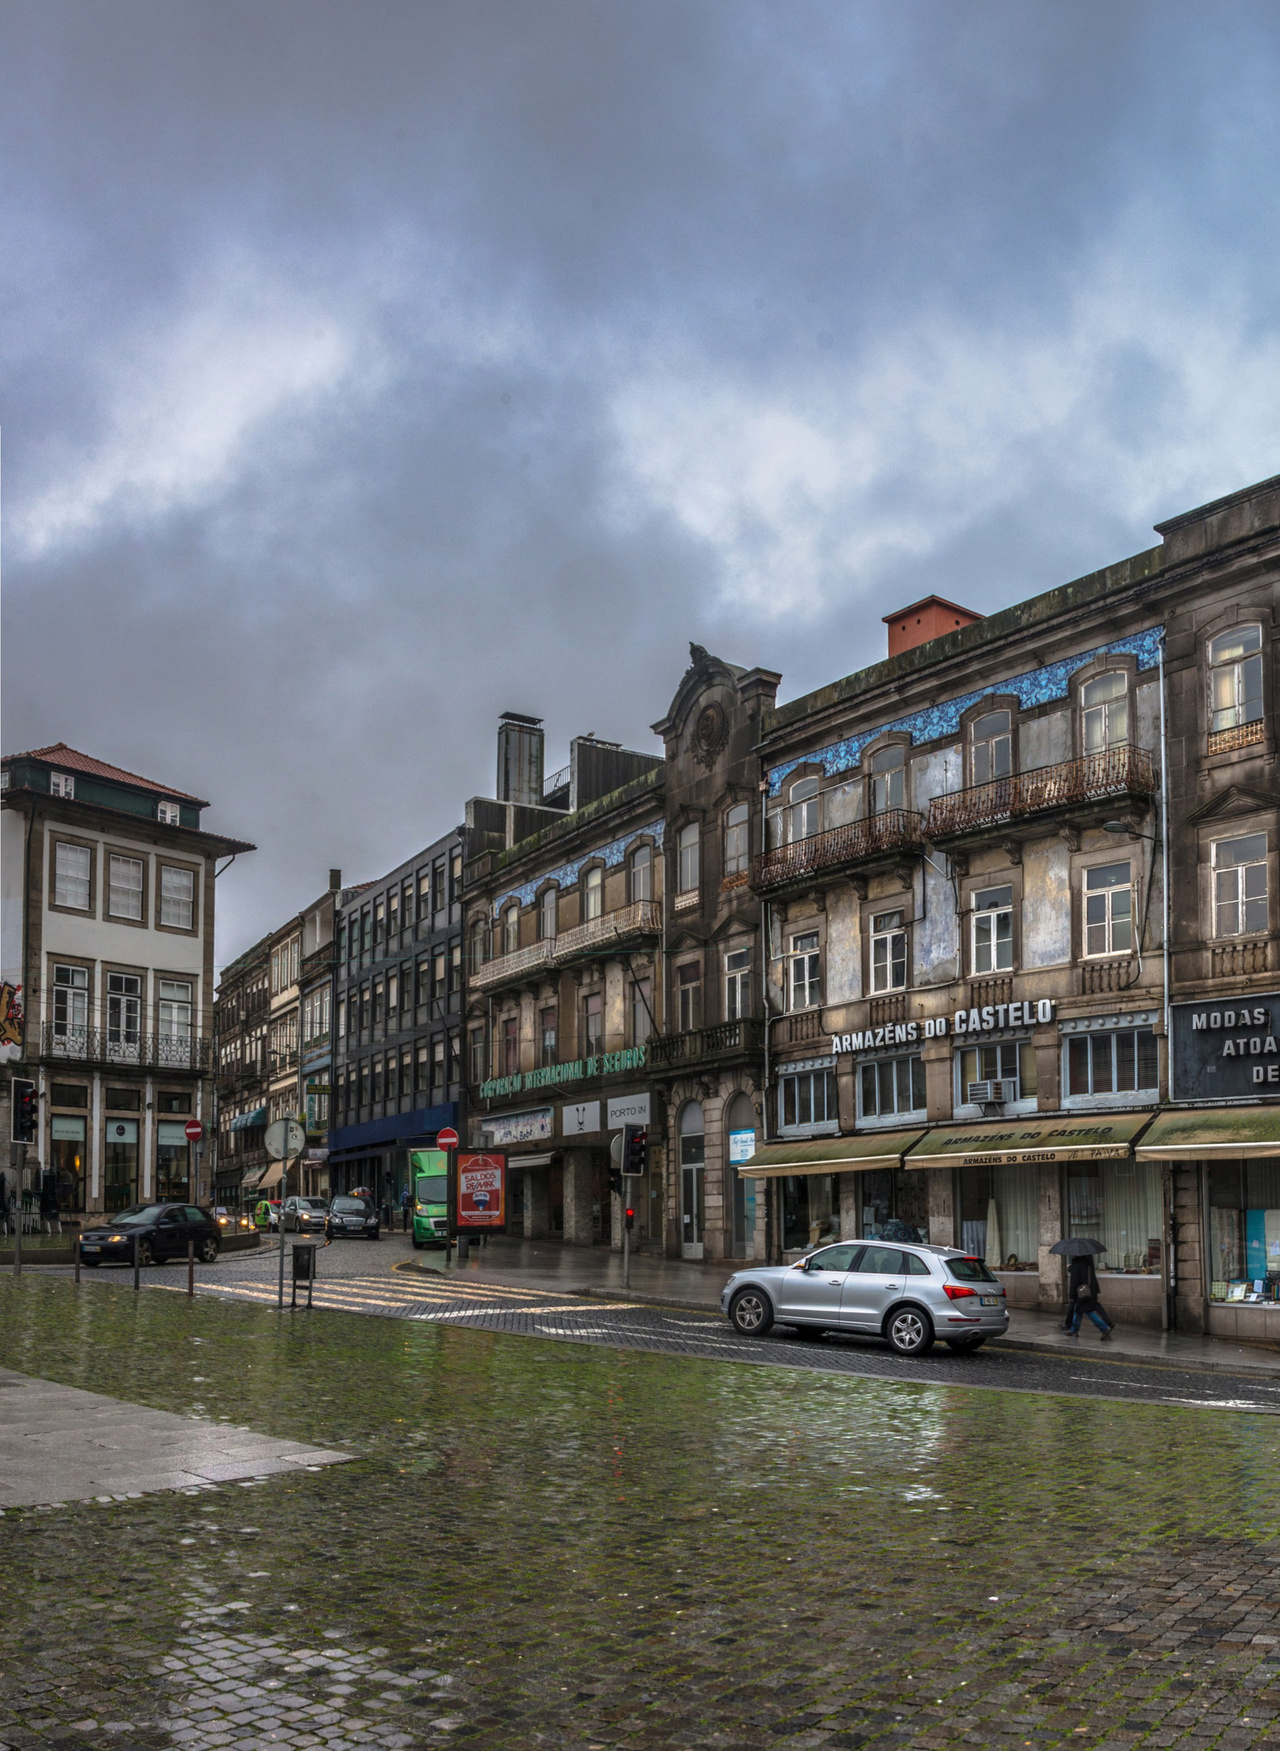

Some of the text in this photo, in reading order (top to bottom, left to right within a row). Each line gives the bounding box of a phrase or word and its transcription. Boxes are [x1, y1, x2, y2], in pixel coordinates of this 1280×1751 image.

[831, 998, 1052, 1054] ARMAZÉNS DO CASTELO
[1191, 1007, 1266, 1030] MODAS
[525, 1059, 584, 1091] INTERNACIONAL
[586, 1055, 599, 1077] DE
[602, 1045, 646, 1075] SEGUROS
[610, 1106, 636, 1118] PORTO
[941, 1126, 1114, 1147] ARMAZÉNS DO CASTELO
[1022, 1153, 1056, 1161] CASTELO
[465, 1171, 496, 1183] SALDOS
[466, 1180, 495, 1191] RE/MAX
